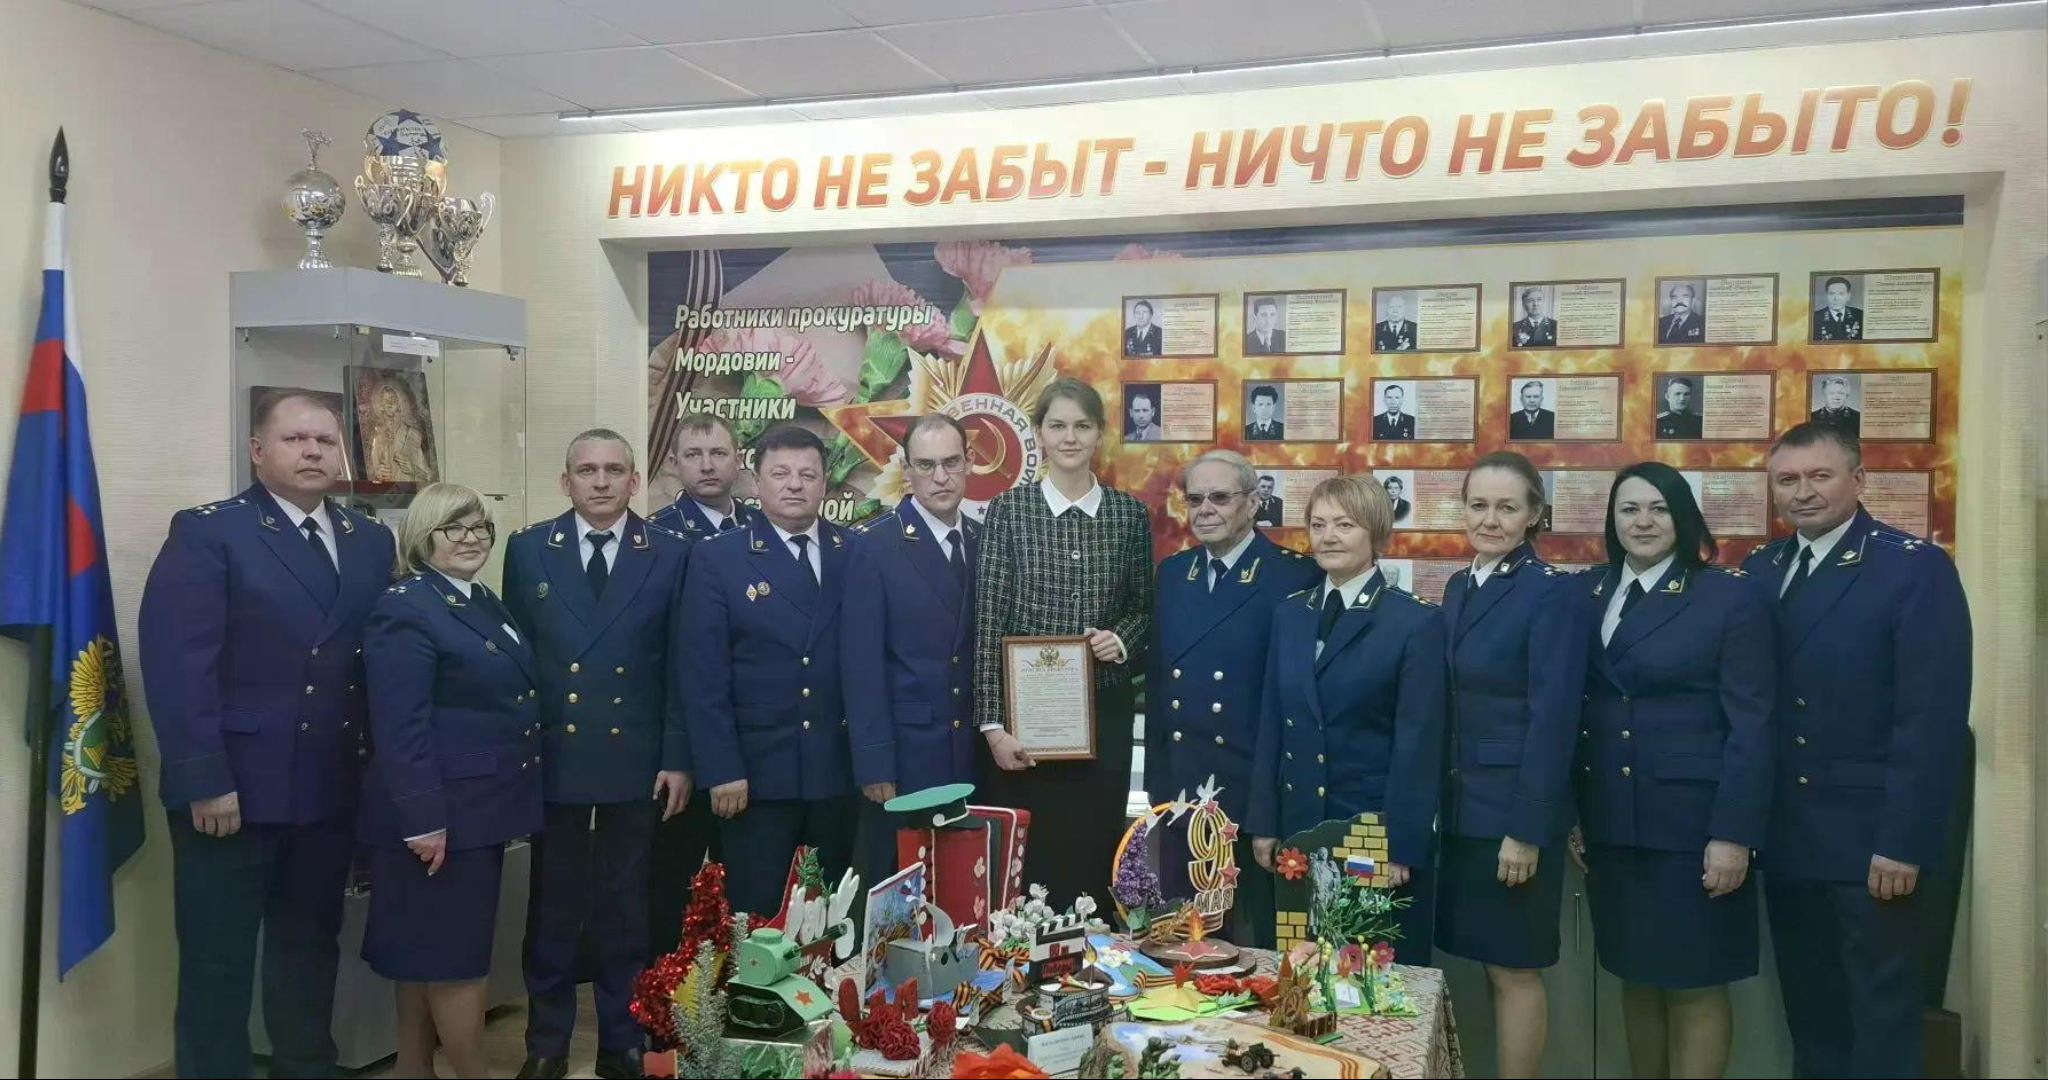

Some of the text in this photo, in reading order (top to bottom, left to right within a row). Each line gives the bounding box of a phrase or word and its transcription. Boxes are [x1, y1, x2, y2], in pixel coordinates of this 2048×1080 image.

[606, 157, 799, 219] НИКТО
[812, 153, 893, 210] НЕ
[902, 136, 1135, 207] ЗАБЫТ
[1184, 115, 1430, 191] НИЧТО
[1446, 107, 1555, 174] НЕ
[1565, 78, 1973, 169] ЗАБЫТО!
[674, 303, 932, 332] Работники прокуратуры
[674, 347, 780, 376] Мордовии
[946, 397, 1028, 432] ВЕННАЯ
